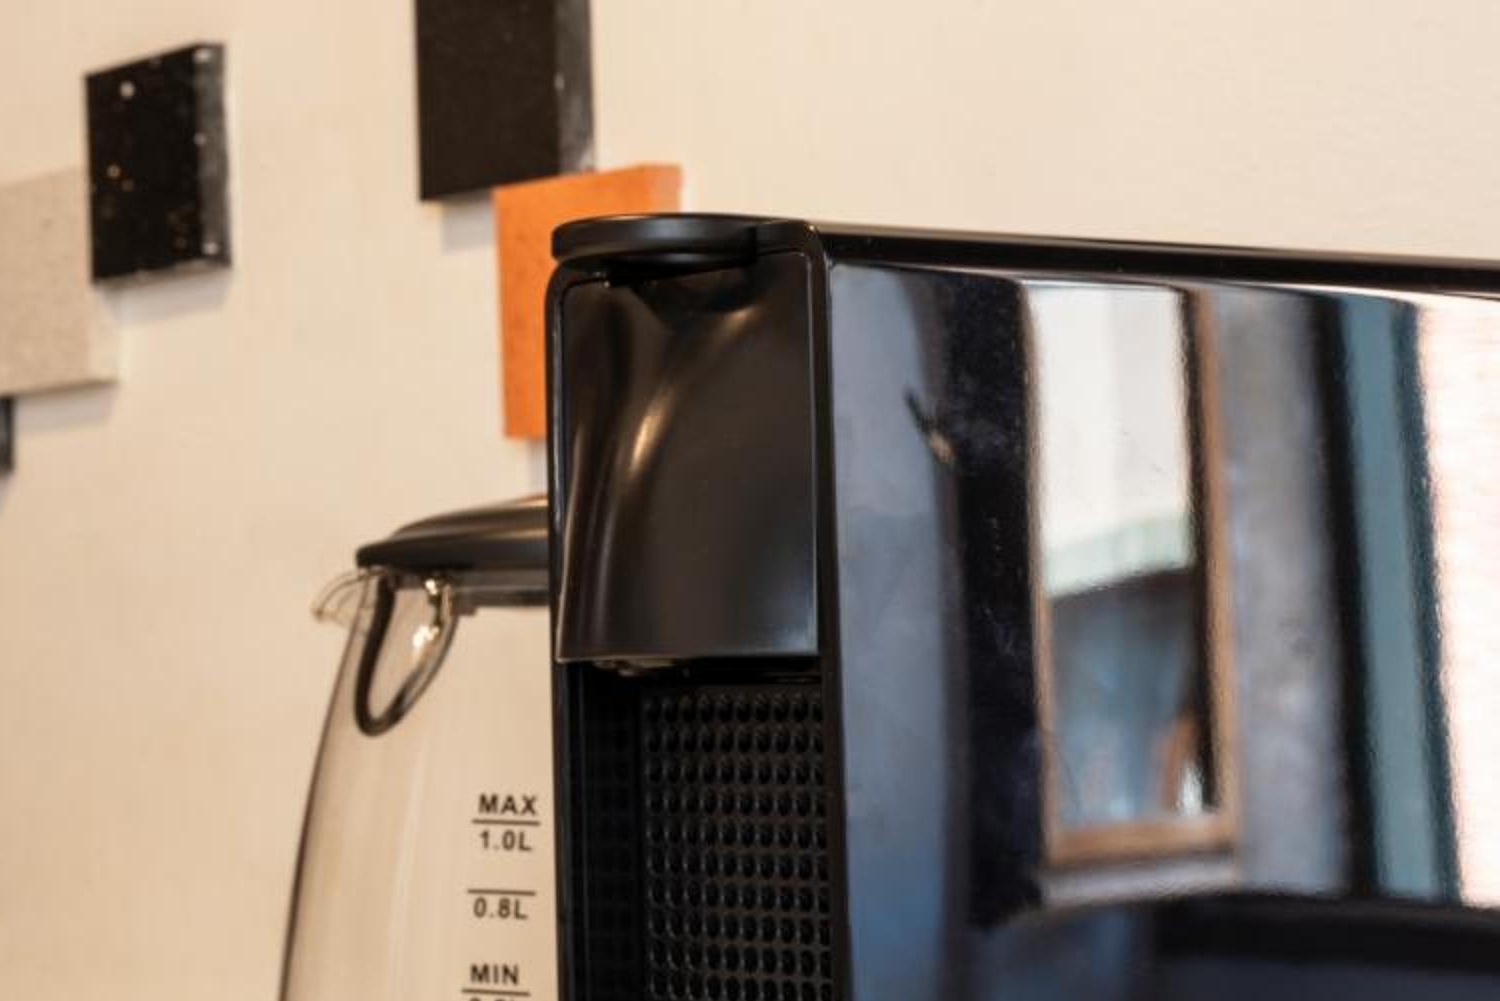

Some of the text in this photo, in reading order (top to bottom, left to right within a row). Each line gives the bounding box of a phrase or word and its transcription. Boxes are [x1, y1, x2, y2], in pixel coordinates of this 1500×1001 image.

[478, 794, 538, 816] MAX
[479, 829, 532, 851] 1.0L
[473, 897, 528, 920] 0.8L
[470, 964, 519, 985] MIN
